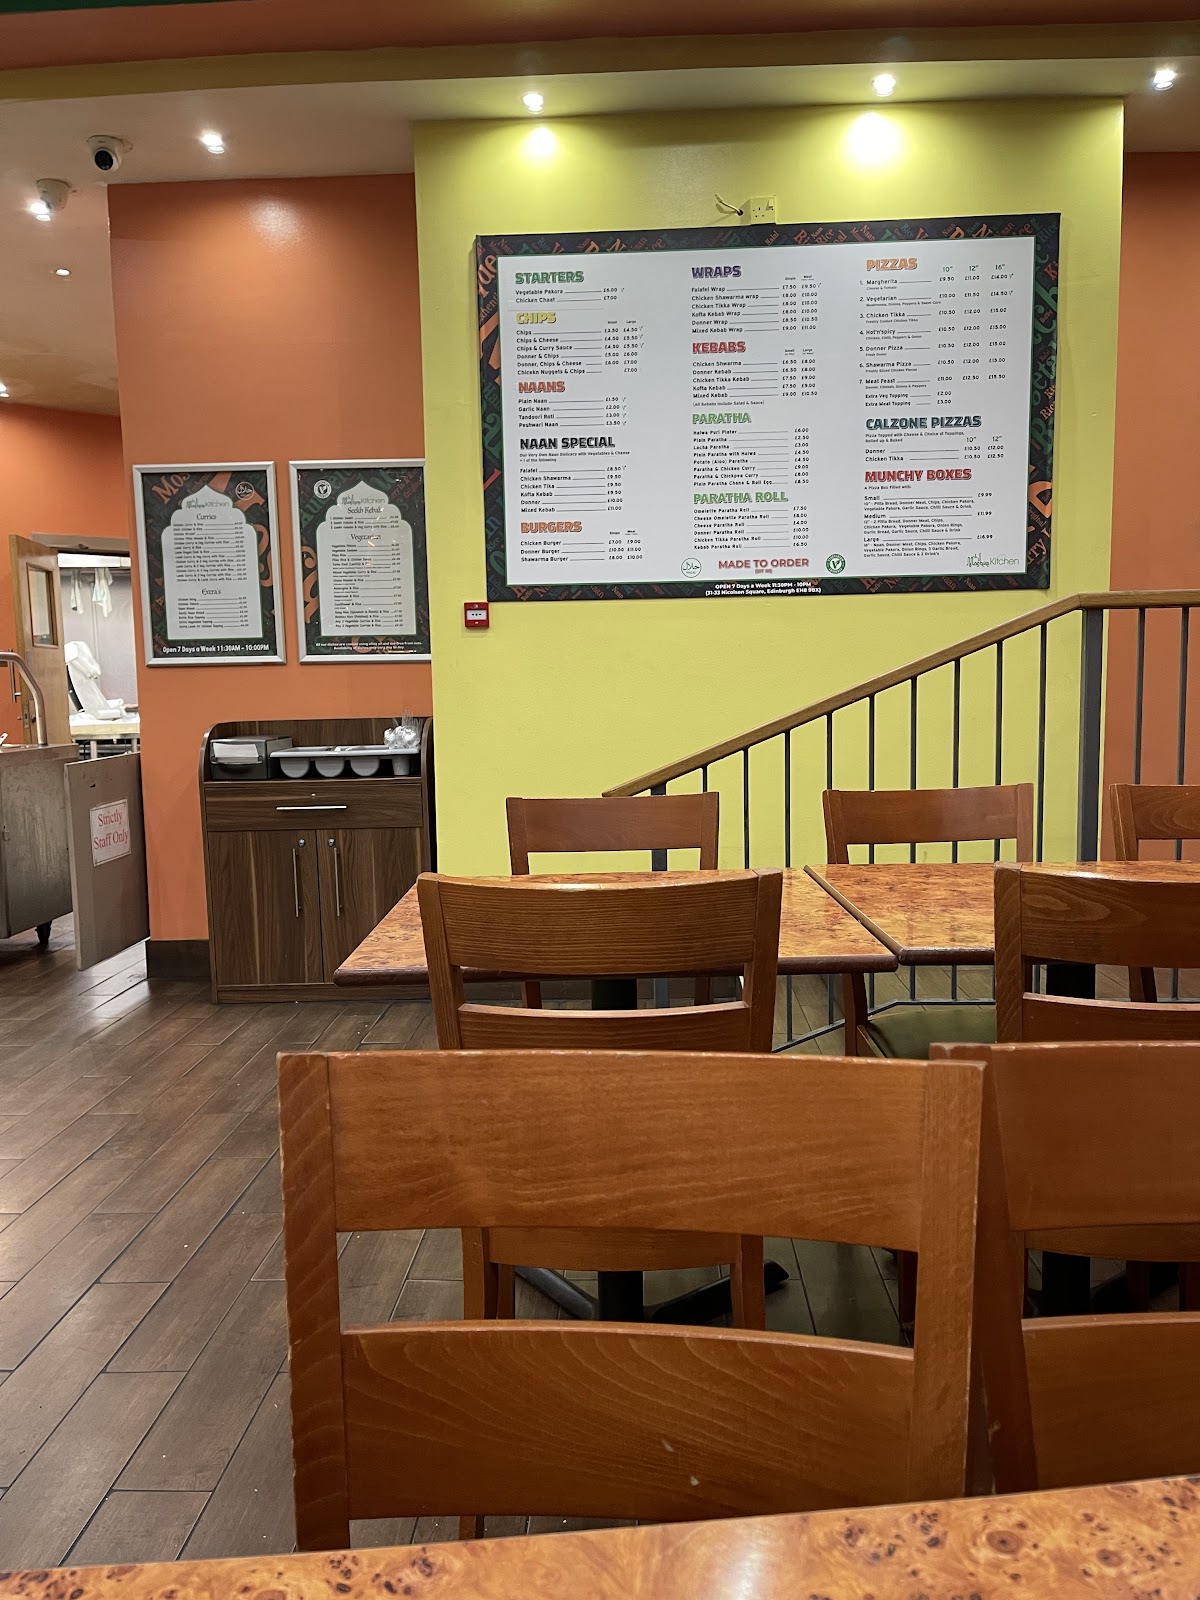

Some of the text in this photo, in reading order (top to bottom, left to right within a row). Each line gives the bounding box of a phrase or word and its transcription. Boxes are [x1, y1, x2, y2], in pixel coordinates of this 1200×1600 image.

[866, 258, 918, 271] PIZZAS
[515, 271, 584, 284] STARTERS
[692, 265, 742, 279] WRAPS
[516, 312, 556, 324] CHIPS
[692, 341, 746, 354] KEBABS
[518, 381, 566, 393] NAANS
[692, 413, 752, 424] PARATHA
[866, 416, 982, 430] CALZONE PIZZAS
[520, 436, 615, 450] NAAN SPECIAL
[865, 469, 972, 482] MUNCHY BOXES
[694, 492, 788, 504] PARATHA ROLL
[520, 521, 582, 534] BURGERS
[719, 558, 809, 569] MADE TO ORDER
[990, 554, 1019, 565] Kitchen
[98, 809, 122, 826] Strictly
[94, 829, 128, 849] Staff Only
